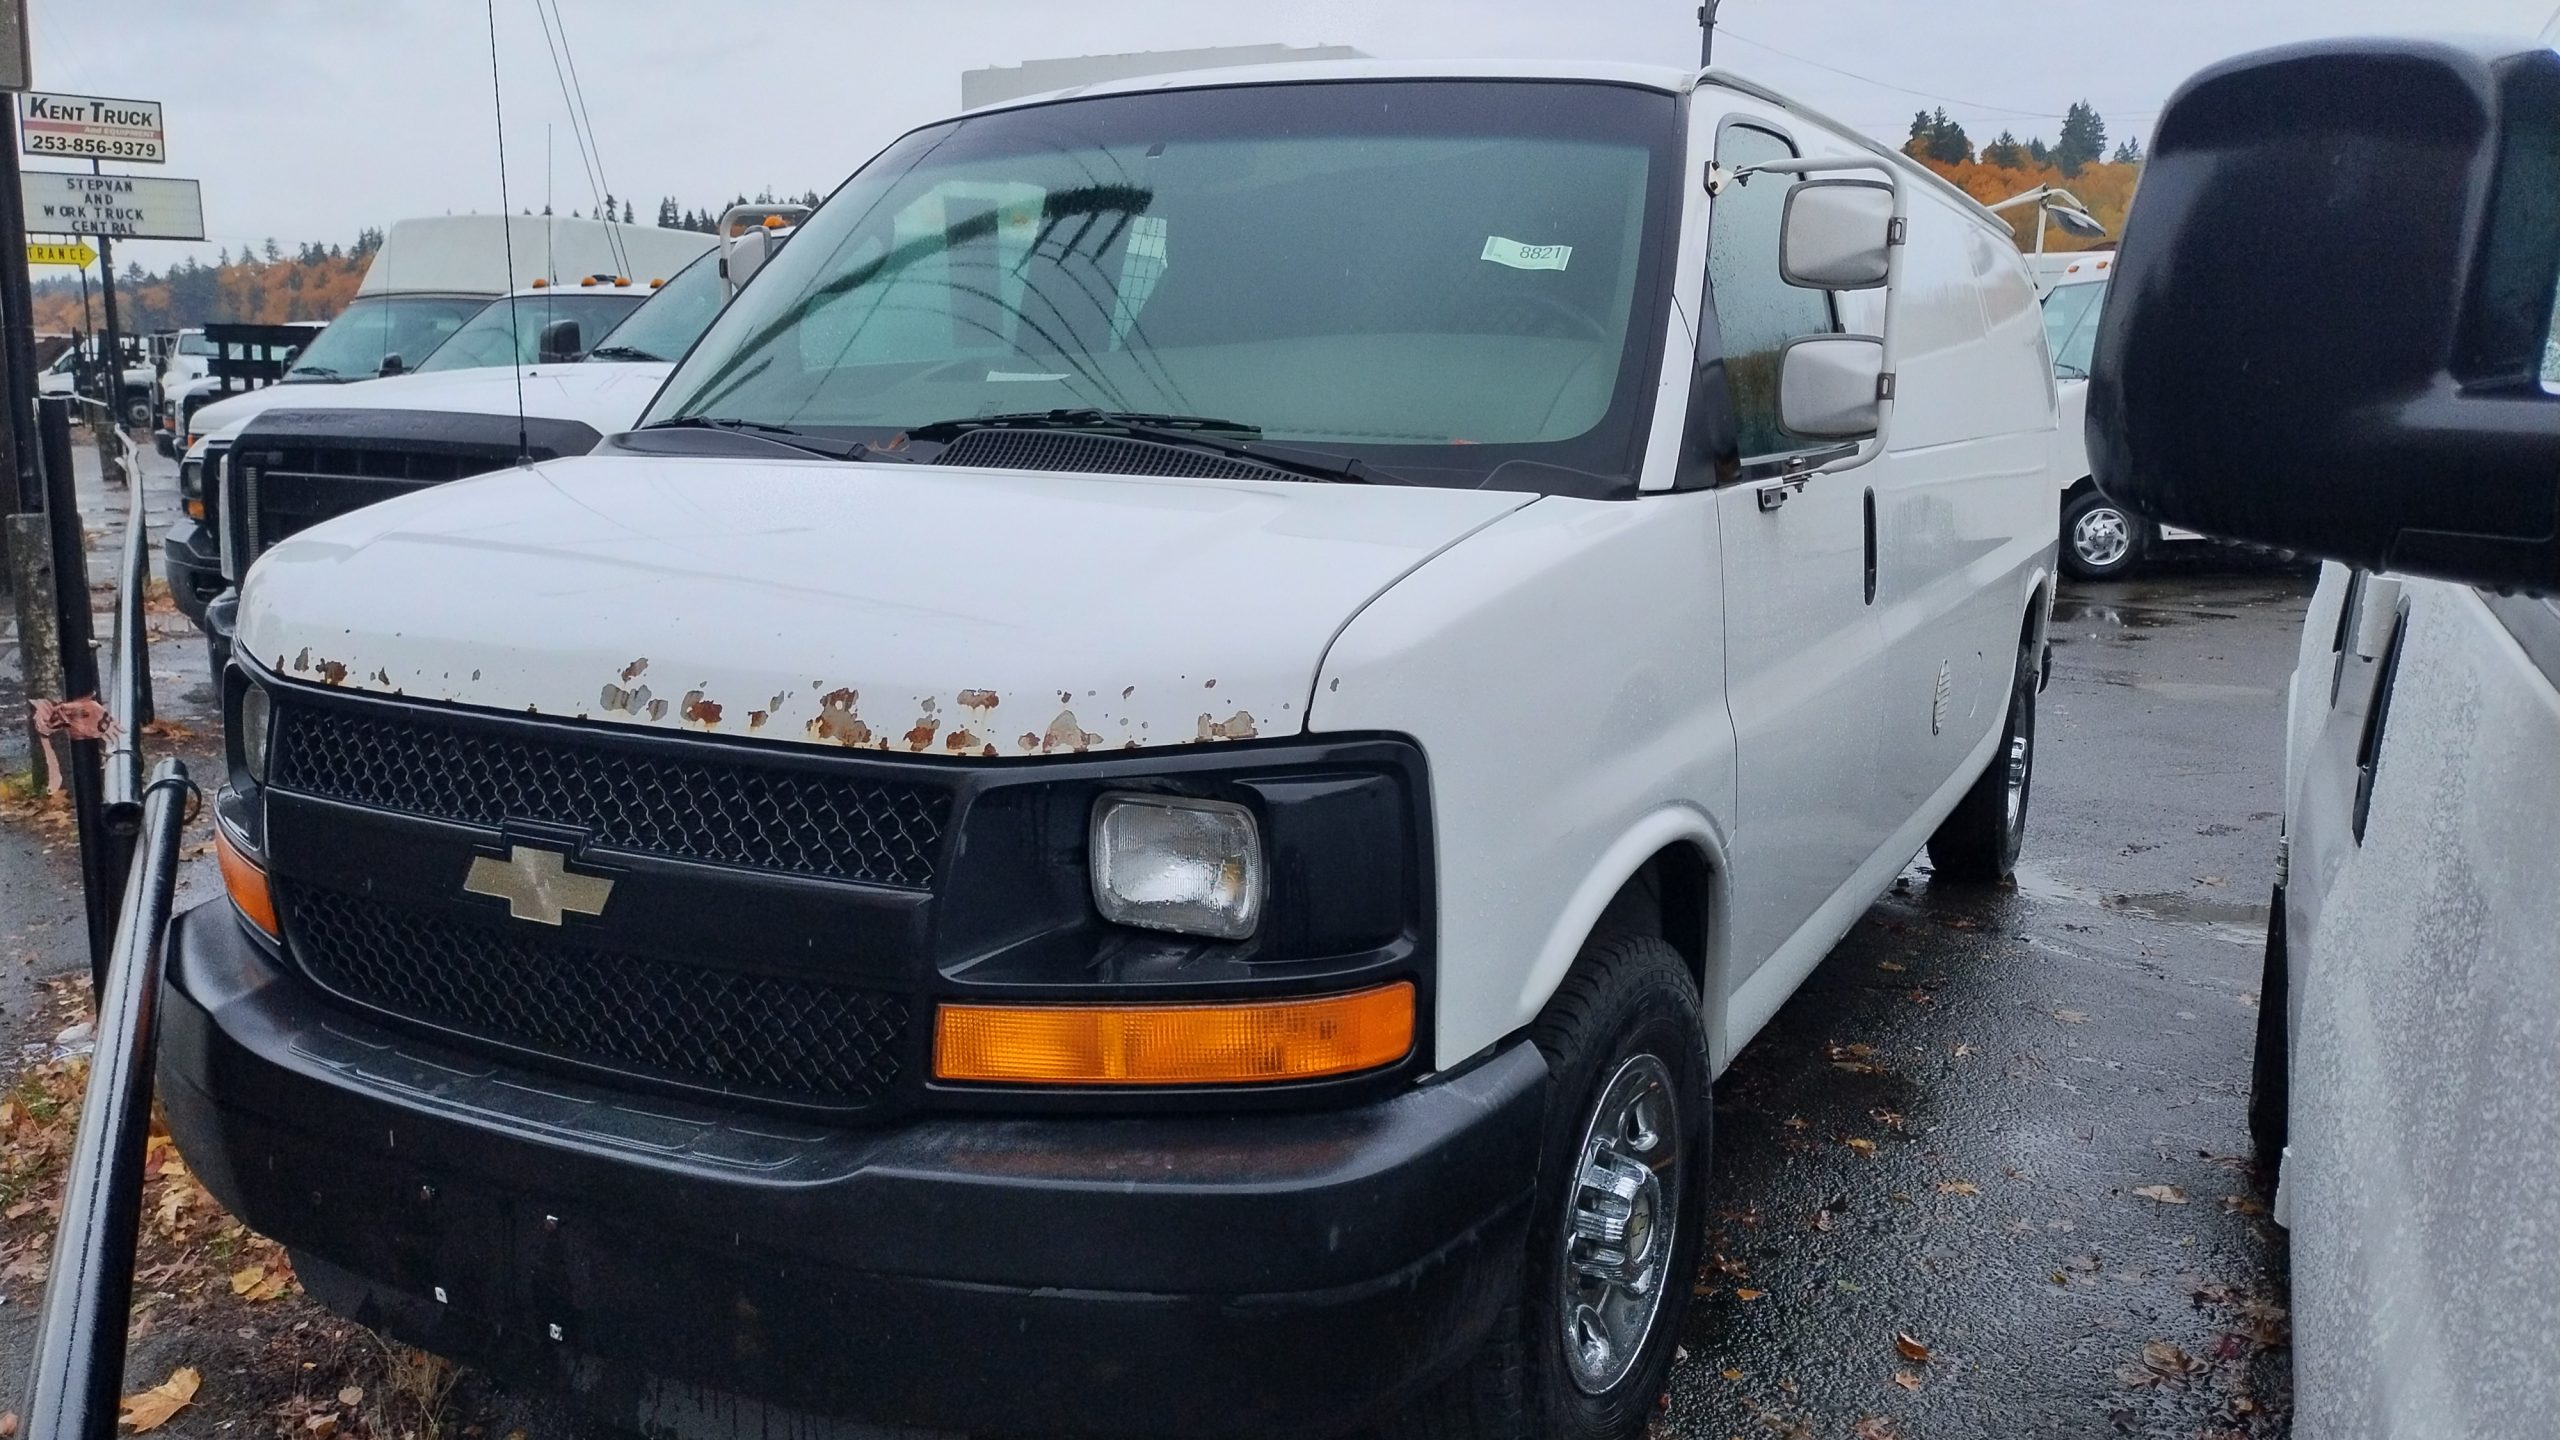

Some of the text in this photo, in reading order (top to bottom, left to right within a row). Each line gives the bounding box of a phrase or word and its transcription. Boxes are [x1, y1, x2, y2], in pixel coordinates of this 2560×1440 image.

[30, 96, 152, 127] KENT TRUCK
[104, 128, 155, 139] EQUIPMENT
[32, 135, 156, 157] 253-856-9379
[67, 178, 133, 192] STEPVAN
[84, 194, 113, 205] AND
[44, 206, 144, 220] WORK TRUCK
[72, 221, 136, 234] CENTRAL
[1519, 246, 1561, 260] 8821
